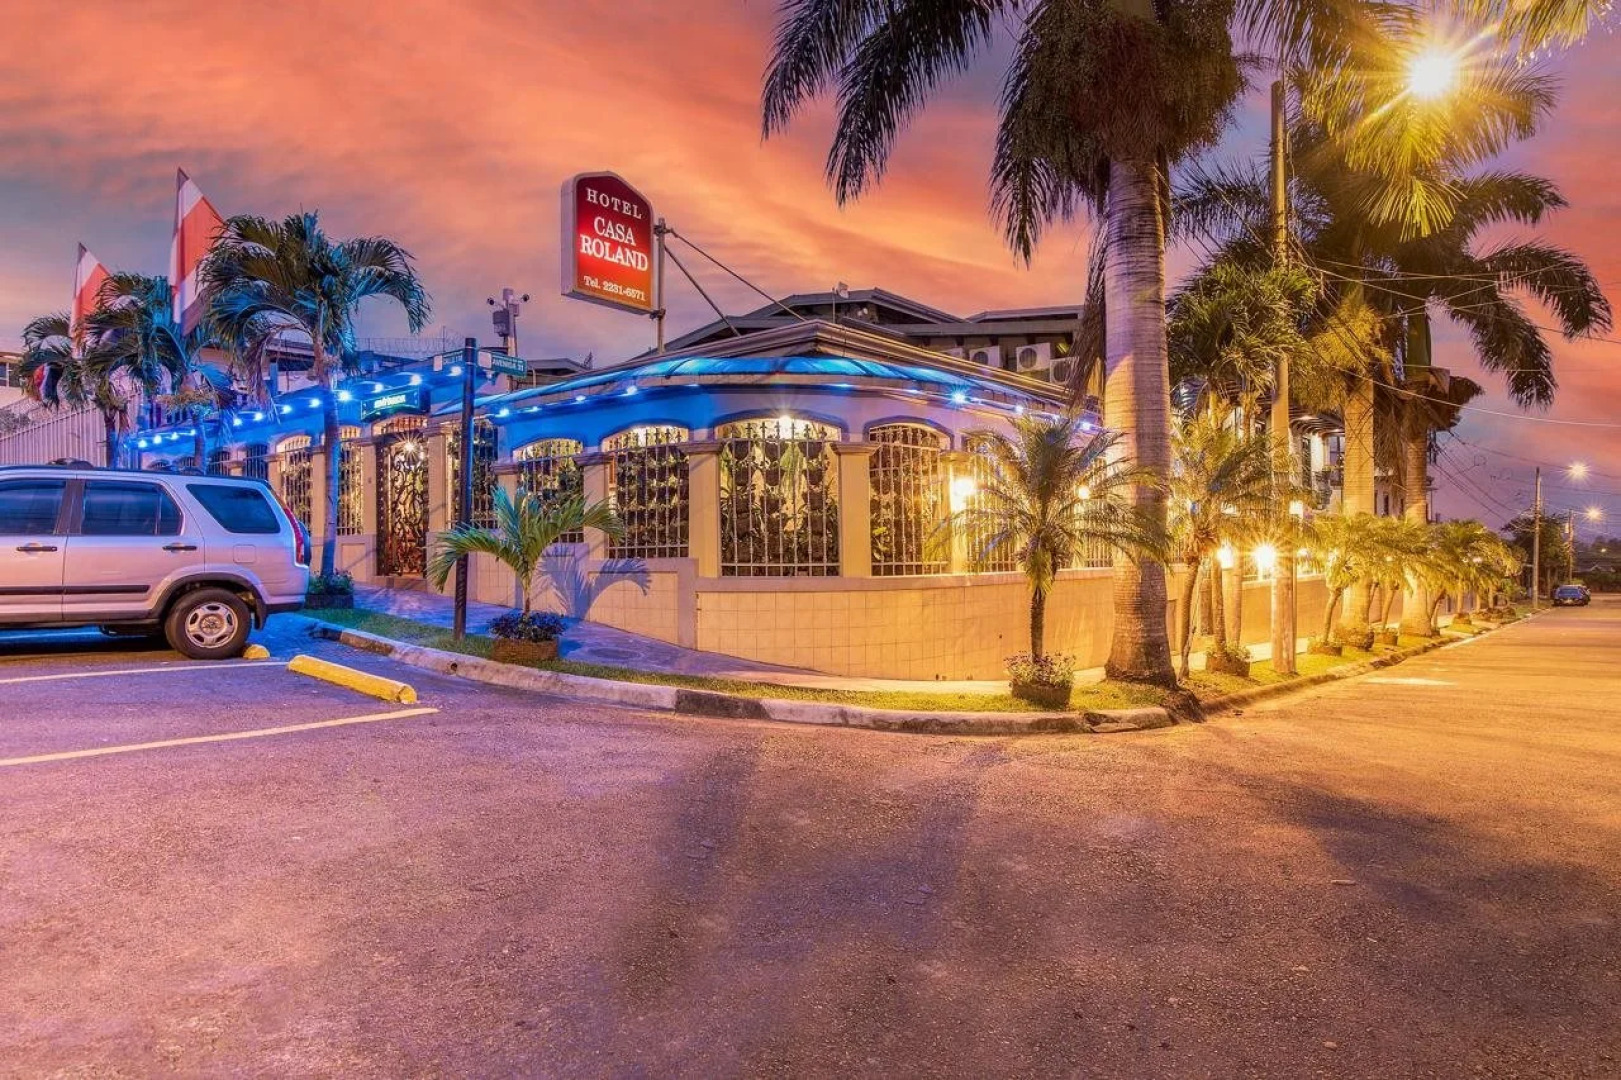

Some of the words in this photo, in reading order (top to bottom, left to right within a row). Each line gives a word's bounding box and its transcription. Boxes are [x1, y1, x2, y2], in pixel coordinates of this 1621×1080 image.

[586, 187, 642, 219] HOTEL
[594, 217, 636, 246] CASA
[580, 234, 648, 271] ROLAND
[583, 275, 600, 289] Tel.
